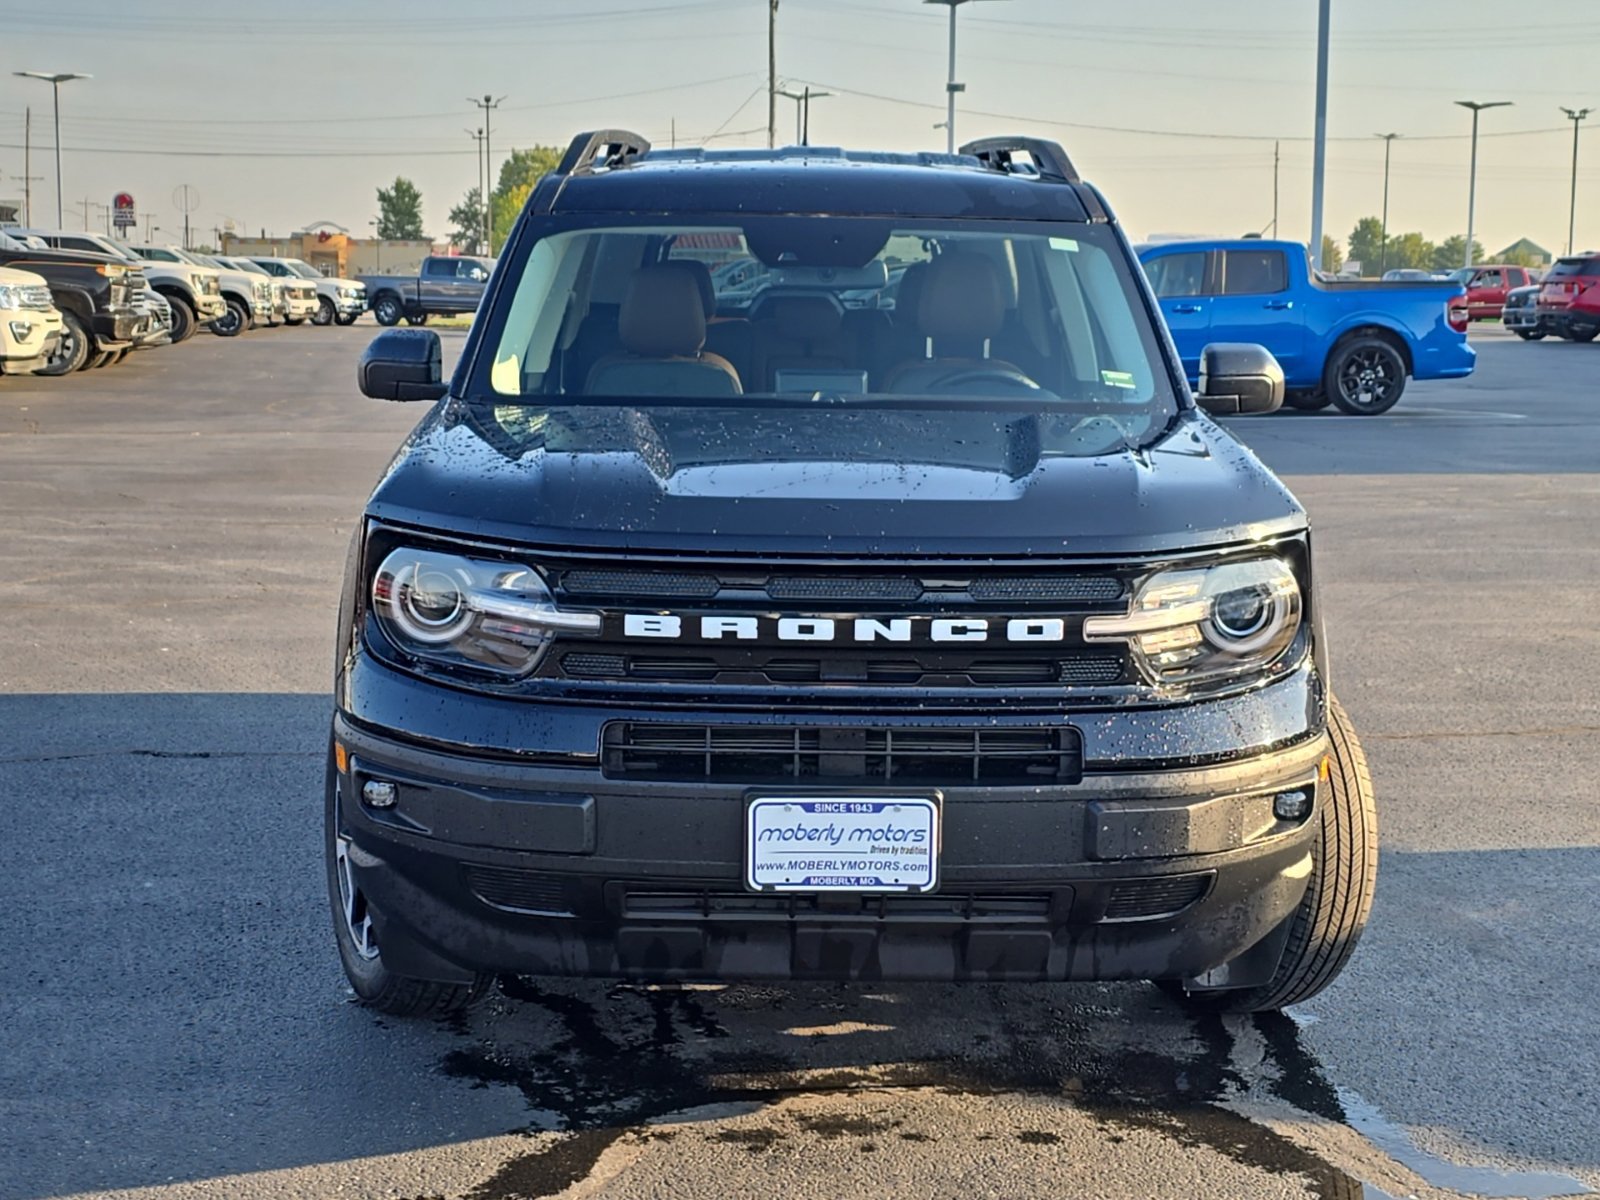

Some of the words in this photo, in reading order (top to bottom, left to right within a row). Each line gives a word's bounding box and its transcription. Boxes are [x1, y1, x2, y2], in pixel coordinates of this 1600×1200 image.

[624, 614, 1064, 641] BRONCO
[814, 804, 846, 813] SINCE
[850, 804, 873, 813] 1943
[758, 823, 844, 845] moberly
[848, 824, 927, 842] motors
[891, 845, 899, 857] by
[756, 860, 928, 871] www.MOBERLYMOTORS.com
[810, 877, 858, 886] MOBERLY,
[862, 877, 876, 886] MO
